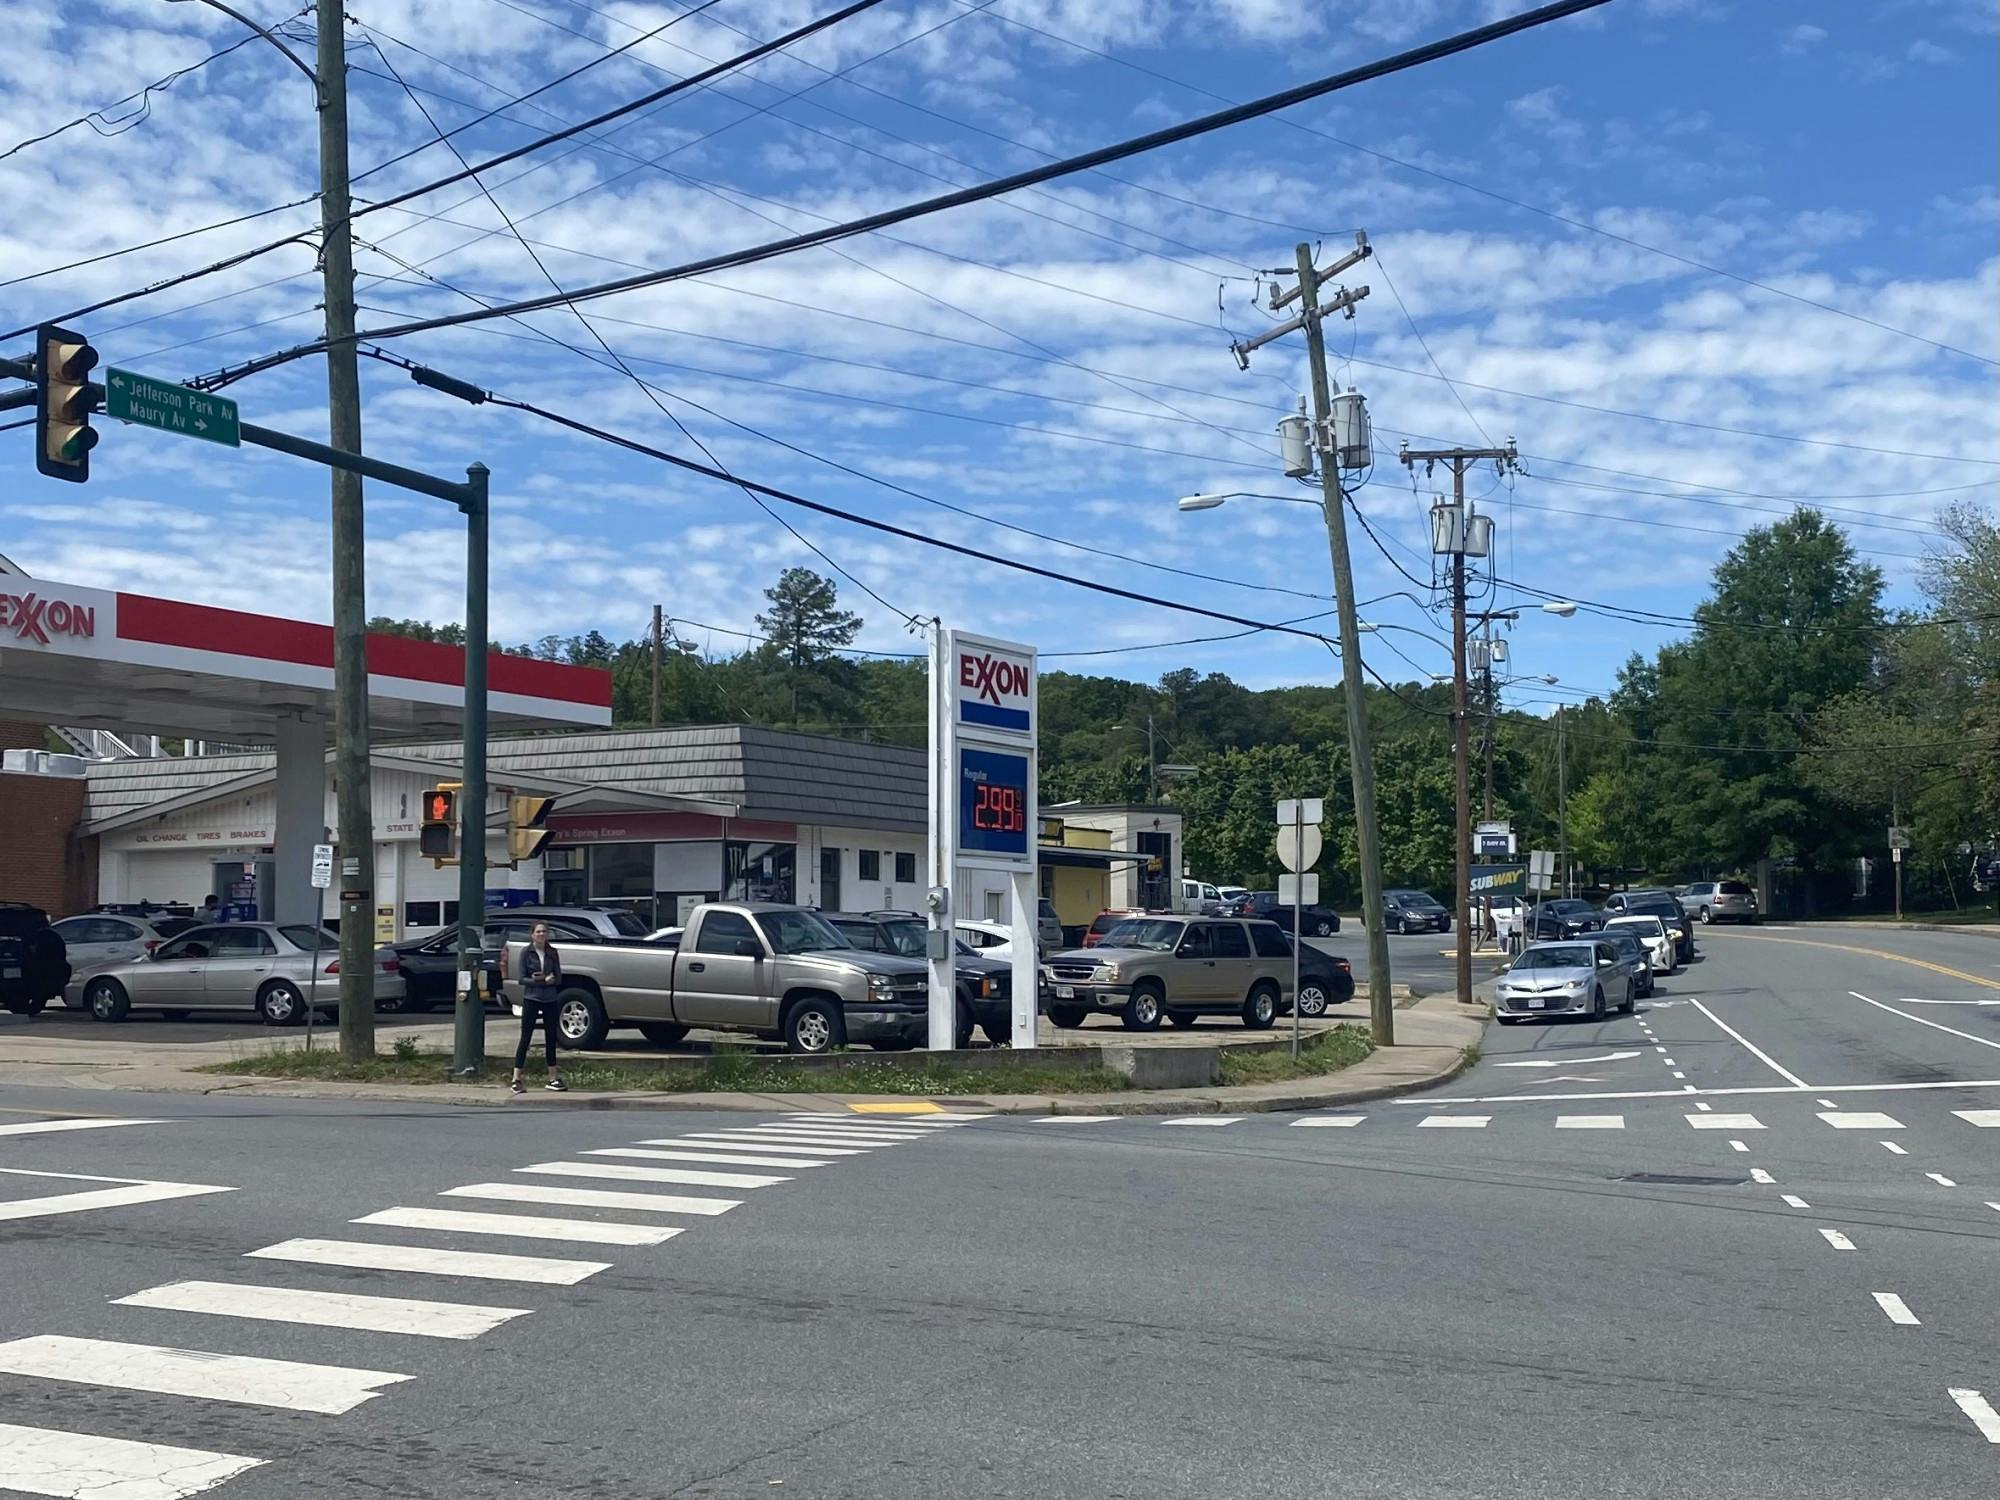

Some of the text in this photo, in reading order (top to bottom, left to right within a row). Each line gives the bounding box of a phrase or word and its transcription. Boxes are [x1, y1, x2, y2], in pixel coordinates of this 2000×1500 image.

[129, 381, 233, 420] Jefferson Park Av
[130, 400, 185, 428] Maury Av
[960, 653, 1028, 705] EXXON
[964, 768, 987, 782] Regular
[136, 830, 266, 843] OIL CHANGE TIRES BRAKES
[386, 824, 413, 832] STATE
[572, 828, 598, 839] Spring
[601, 827, 626, 836] Exxon
[1469, 868, 1524, 892] SUBWAY
